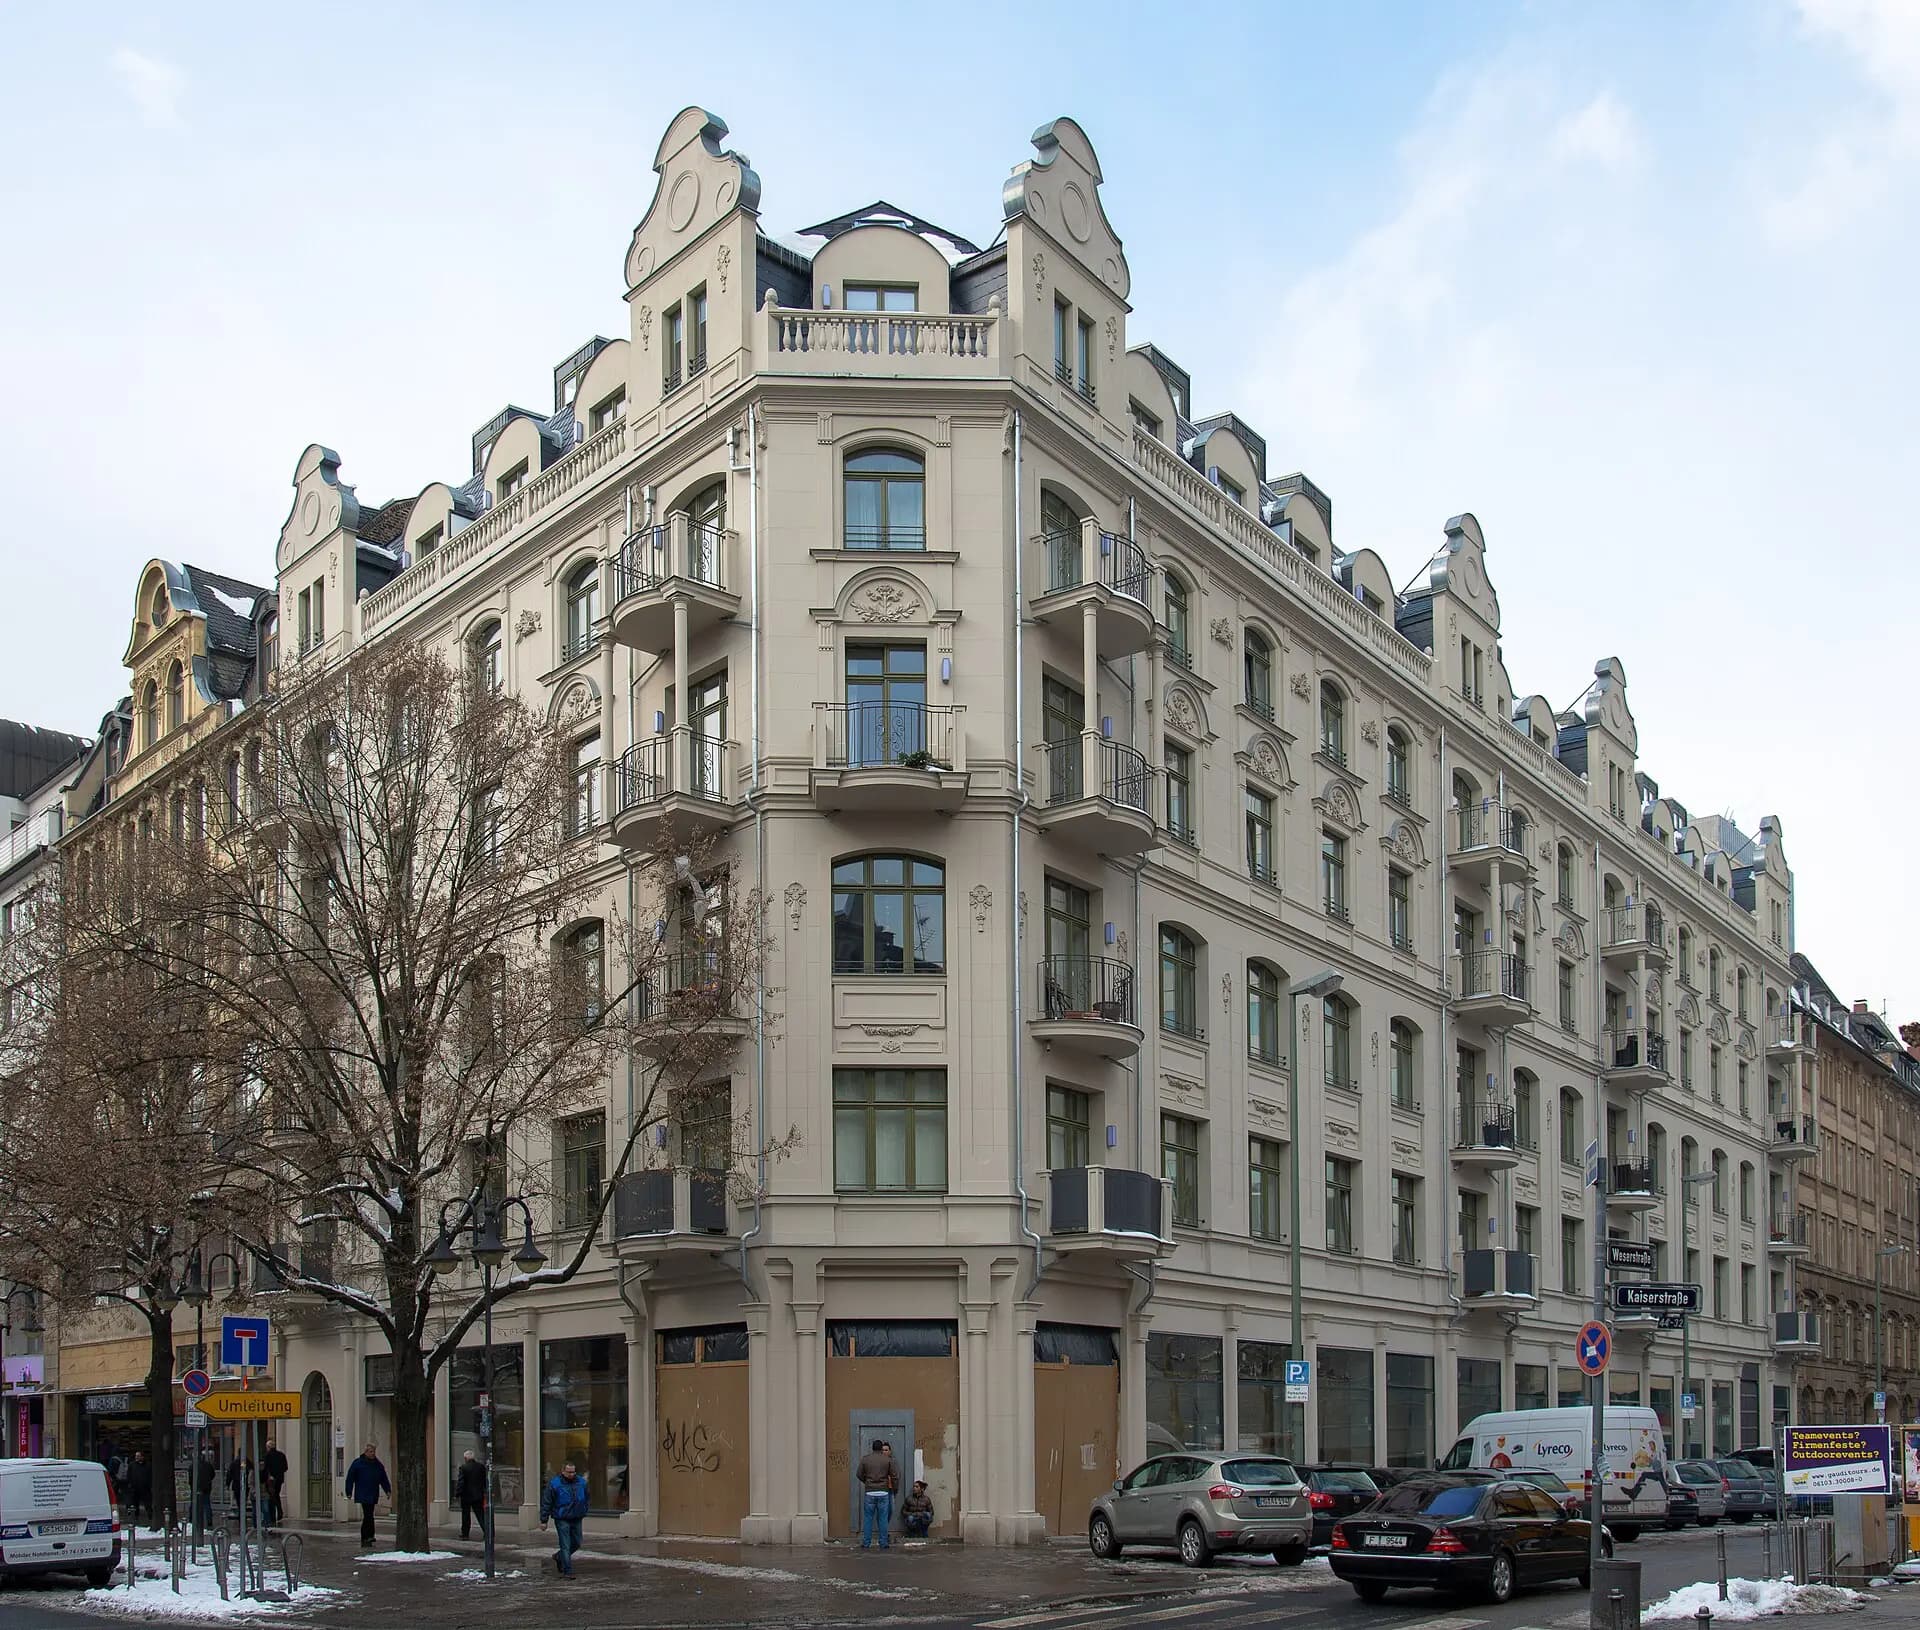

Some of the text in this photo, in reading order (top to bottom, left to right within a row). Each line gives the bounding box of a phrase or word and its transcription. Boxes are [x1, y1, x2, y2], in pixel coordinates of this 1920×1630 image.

[1612, 1247, 1651, 1266] Weserstraße
[1627, 1289, 1689, 1306] Kaiserstraße
[1290, 1364, 1302, 1382] P
[219, 1399, 292, 1415] Umleitung
[1792, 1431, 1860, 1440] Teamevents?
[1537, 1443, 1571, 1458] Lyreco
[1792, 1441, 1867, 1449] Firmenfeste?
[1792, 1450, 1880, 1459] Outdoorevents?
[1812, 1466, 1880, 1479] www.gauditours.de
